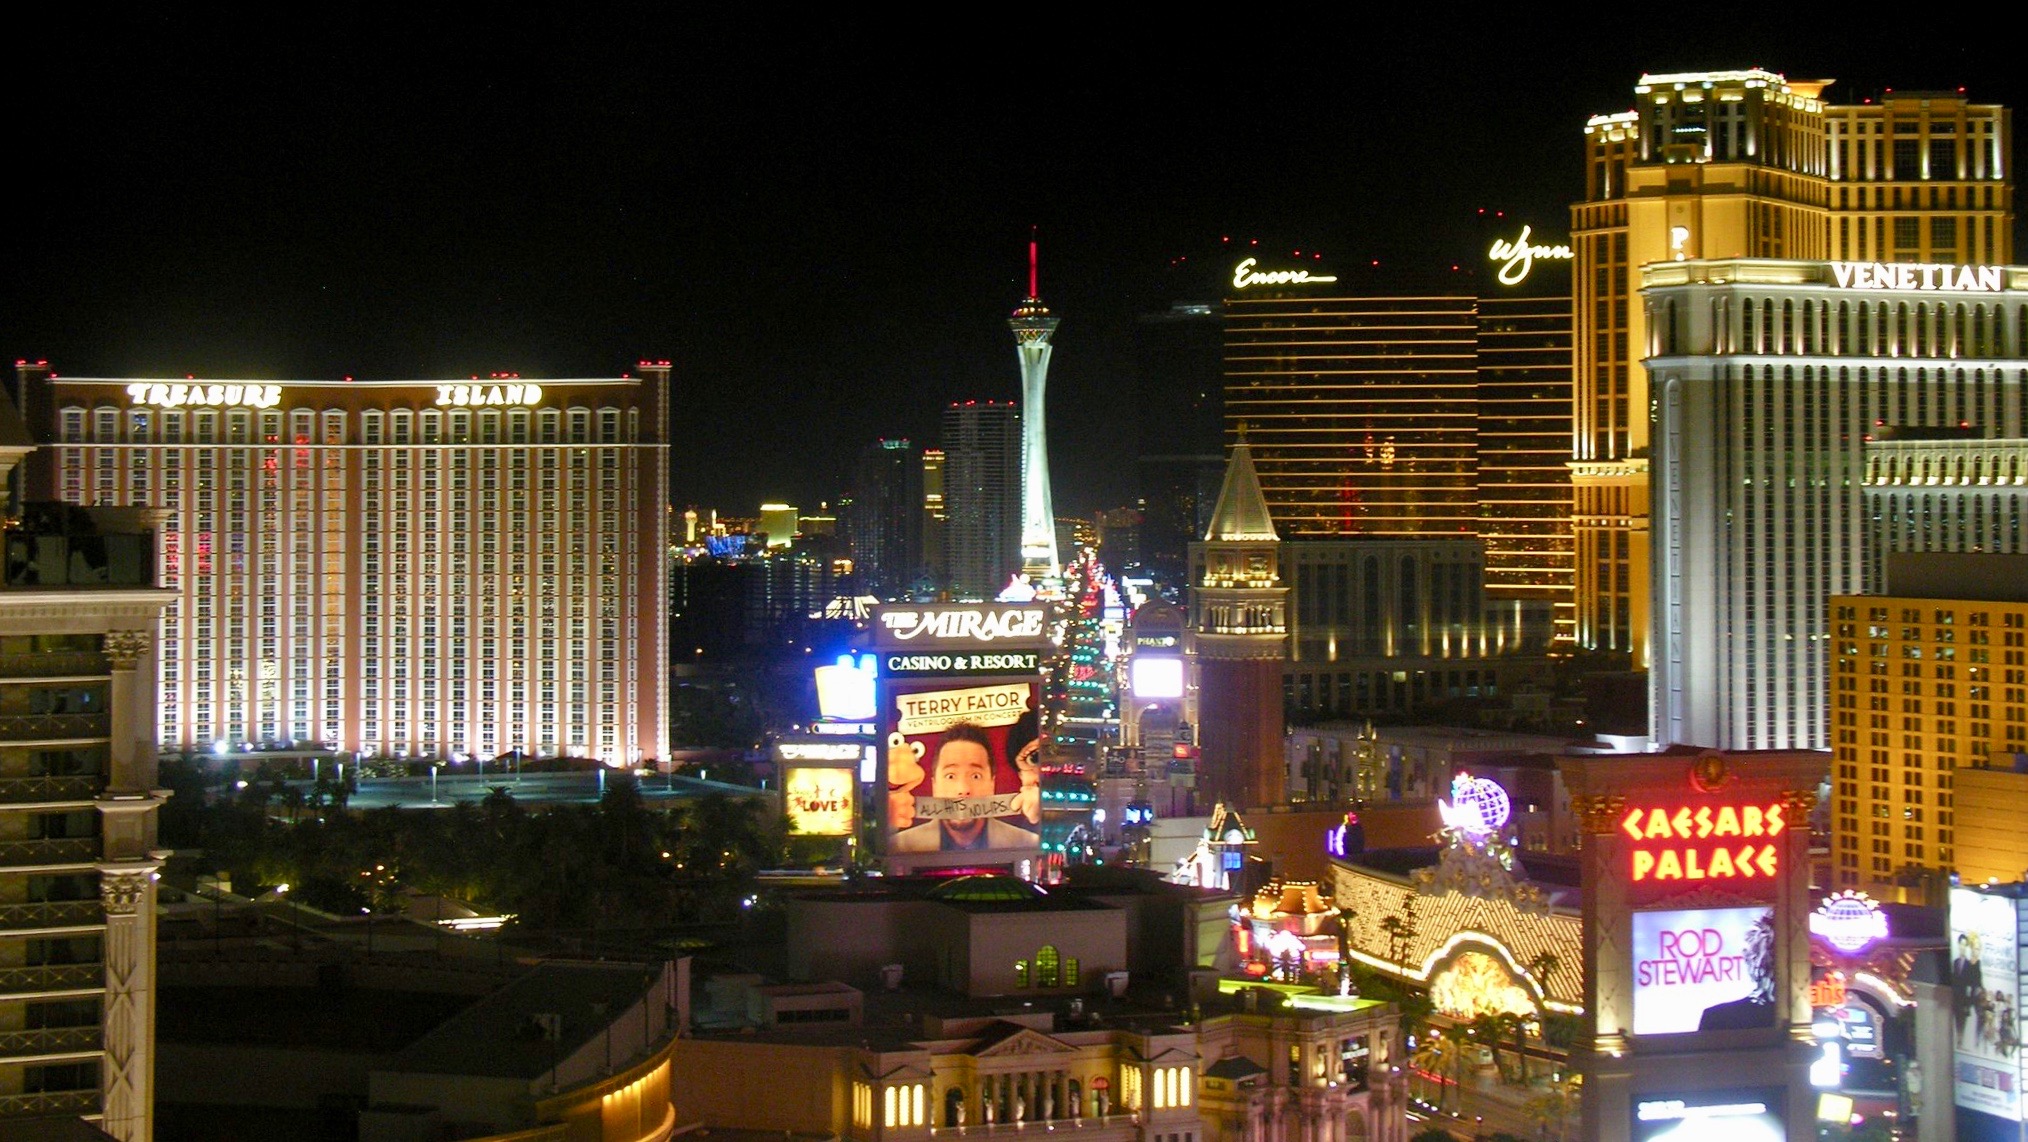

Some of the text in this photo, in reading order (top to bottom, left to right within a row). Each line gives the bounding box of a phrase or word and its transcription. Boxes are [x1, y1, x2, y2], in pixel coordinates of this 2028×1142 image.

[1233, 258, 1337, 288] Encore
[1830, 261, 2002, 291] VENETIAN
[127, 383, 542, 408] TREASURE ISLAND
[881, 610, 1043, 641] THE MIRAGE
[1137, 637, 1178, 646] PHANT
[888, 655, 1037, 670] CASINO & RESORT
[906, 692, 1019, 716] TERRY FATOR
[803, 800, 837, 812] LOVE
[1622, 804, 1785, 840] CAESARS
[1633, 845, 1777, 881] PALACE
[1660, 929, 1723, 958] ROD
[1639, 956, 1743, 986] STEWART
